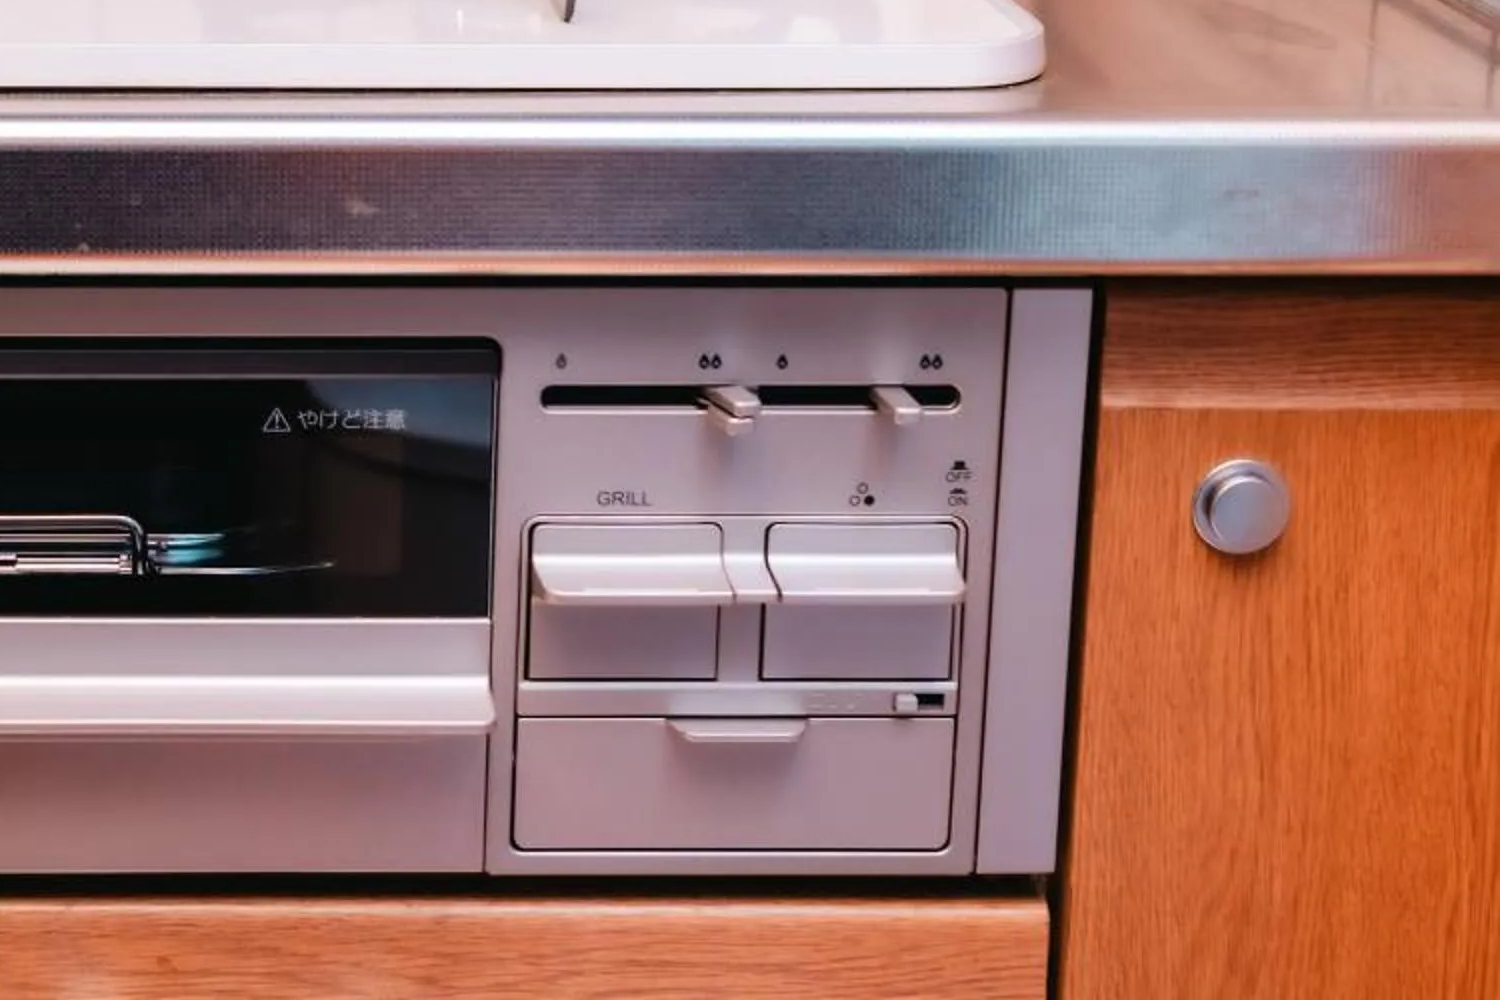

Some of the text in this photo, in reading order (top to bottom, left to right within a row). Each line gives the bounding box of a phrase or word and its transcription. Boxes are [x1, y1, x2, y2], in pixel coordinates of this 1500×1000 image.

[298, 409, 405, 430] やけど注意
[945, 471, 973, 483] OFF
[596, 490, 654, 507] GRILL
[947, 496, 969, 507] ON
